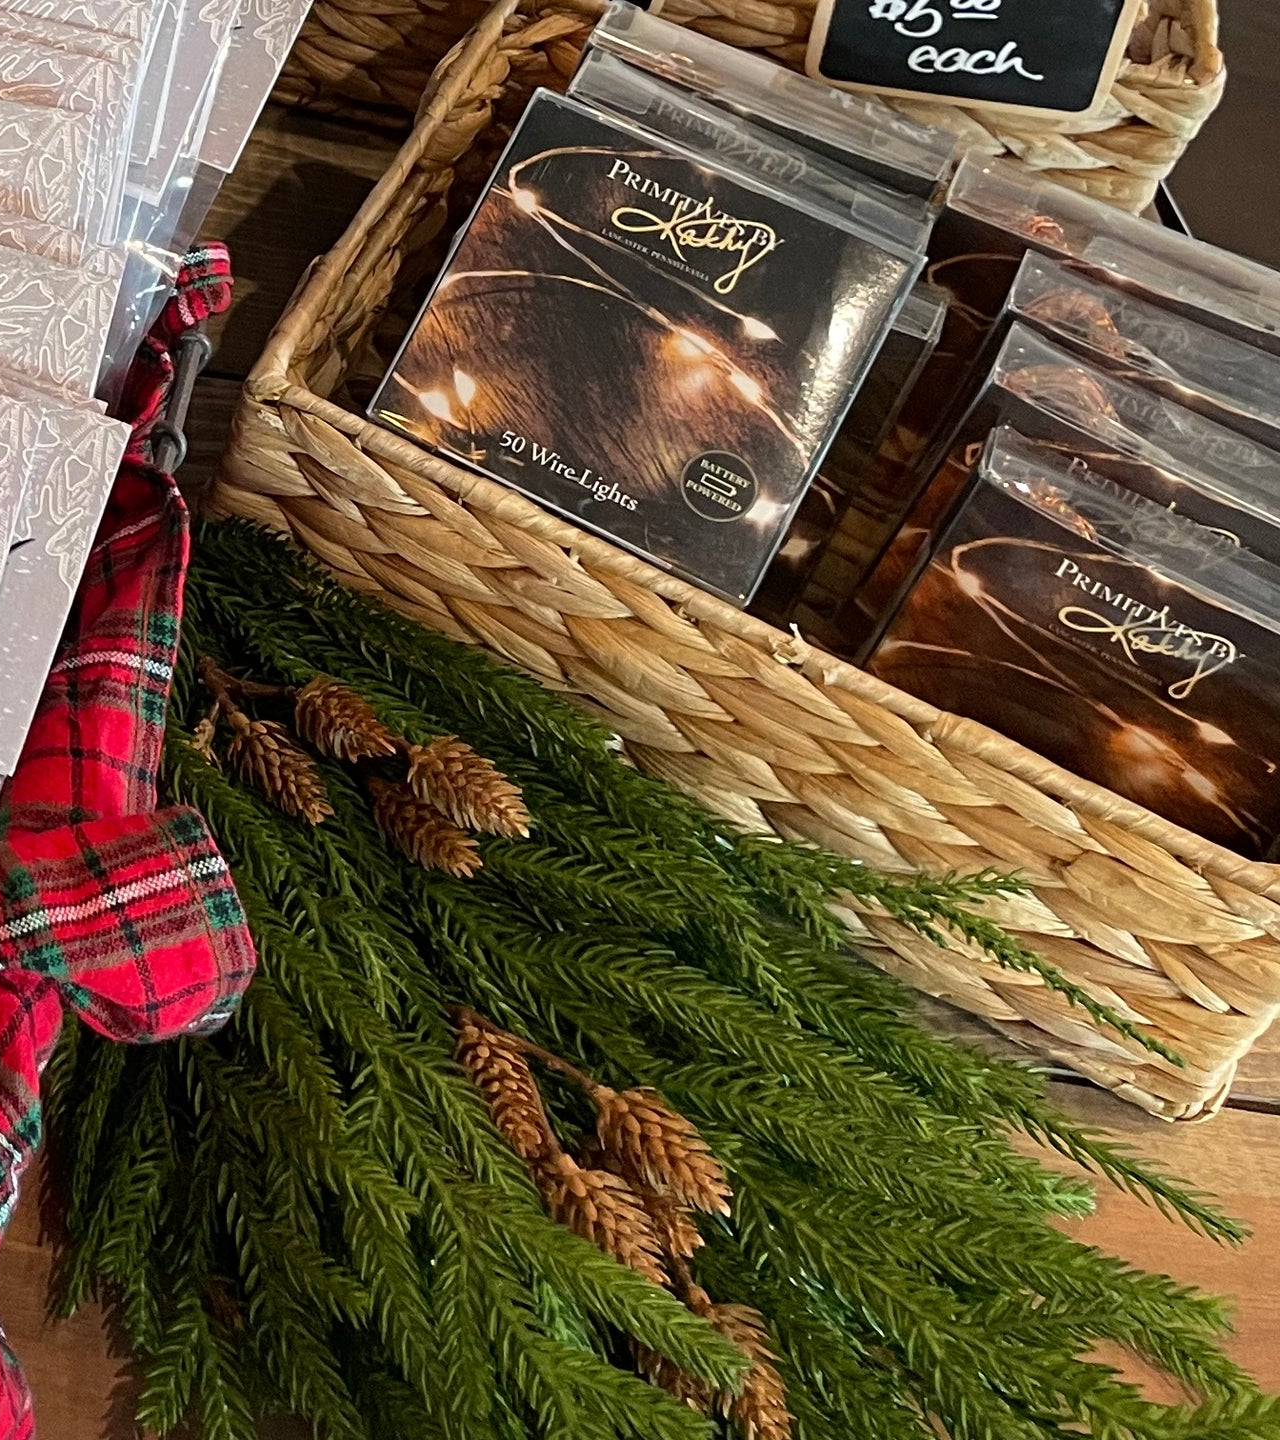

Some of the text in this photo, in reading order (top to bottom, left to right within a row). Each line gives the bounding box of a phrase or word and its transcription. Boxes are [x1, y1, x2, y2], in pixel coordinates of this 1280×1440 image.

[907, 40, 1044, 82] each
[610, 195, 778, 295] Kathy
[499, 429, 639, 512] 50 Wire Lights
[685, 479, 743, 513] POWERED
[699, 458, 752, 490] BATTERY
[1058, 605, 1237, 700] Kathy
